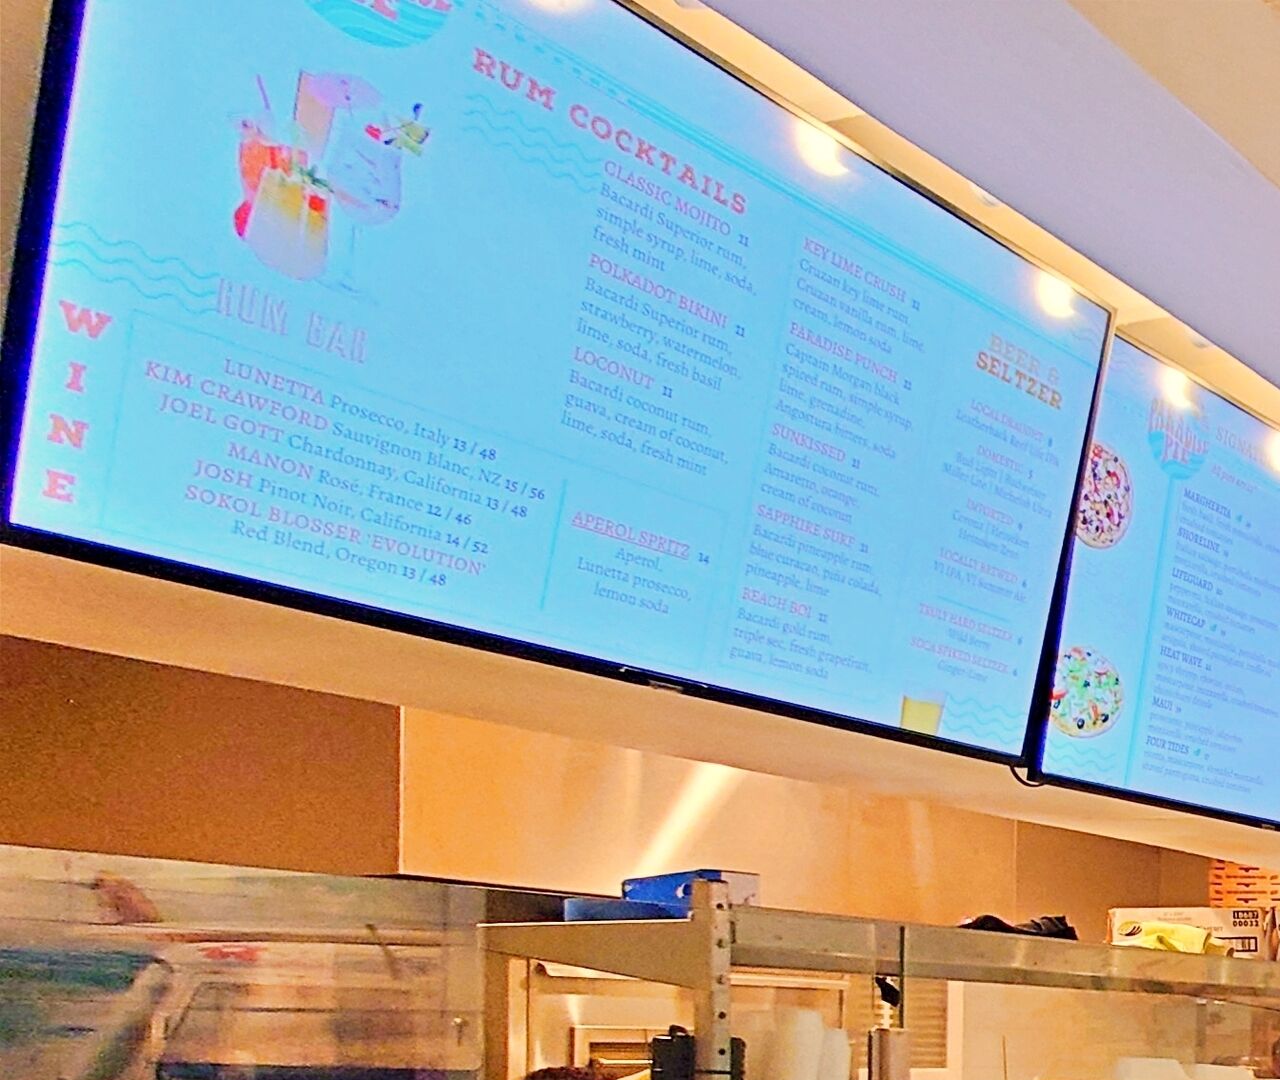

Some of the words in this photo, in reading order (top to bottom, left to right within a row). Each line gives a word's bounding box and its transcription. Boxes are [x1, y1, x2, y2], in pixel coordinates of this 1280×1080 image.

[472, 46, 556, 112] RUM
[568, 99, 747, 215] COCKTAILS
[600, 182, 653, 220] Bacardi
[656, 211, 714, 254] Superior
[715, 245, 747, 270] rum,
[603, 158, 672, 206] CLASSIC
[674, 196, 731, 238] MOJITO
[592, 223, 629, 254] fresh
[632, 243, 666, 272] mint
[595, 201, 644, 241] simple
[646, 230, 688, 263] syrup,
[690, 249, 723, 279] lime,
[724, 266, 758, 296] soda,
[803, 236, 829, 261] KEY
[830, 251, 863, 279] LIME
[863, 270, 906, 303] CRUSH
[214, 275, 292, 338] RUM
[304, 309, 370, 366] BAR
[584, 276, 638, 312] Bacardi
[640, 302, 699, 343] Superior
[701, 333, 733, 357] rum,
[589, 252, 676, 305] POLKADOT
[677, 294, 727, 329] BIKINI
[573, 345, 655, 391] LOCONUT
[576, 317, 614, 349] lime,
[615, 334, 654, 366] soda,
[655, 351, 690, 378] fresh
[691, 367, 722, 392] basil
[579, 297, 661, 347] strawberry,
[662, 334, 742, 381] watermelon,
[789, 321, 853, 363] PARADISE
[854, 353, 897, 384] PUNCH
[42, 300, 114, 504] WINE
[224, 358, 326, 405] LUNETTA
[329, 394, 408, 436] Prosecco,
[412, 422, 451, 451] Italy
[451, 439, 466, 456] 13
[478, 444, 497, 466] 48
[569, 368, 623, 402] Bacardi
[625, 391, 679, 424] coconut
[680, 417, 712, 439] rum,
[976, 350, 1062, 410] SELTZER
[144, 360, 192, 389] KIM
[199, 378, 328, 433] CRAWFORD
[331, 421, 422, 466] Sauvignon
[425, 452, 474, 482] Blanc,
[478, 469, 501, 488] NZ
[503, 481, 518, 497] 15
[528, 485, 545, 506] 56
[160, 393, 217, 425] JOEL
[222, 412, 284, 445] GOTT
[286, 432, 400, 484] Chardonnay,
[403, 469, 482, 506] California
[484, 498, 499, 515] 13
[510, 502, 528, 523] 48
[560, 410, 598, 439] lime,
[599, 425, 638, 453] soda,
[639, 440, 674, 464] fresh
[676, 453, 707, 476] mint
[564, 393, 611, 423] guava,
[614, 412, 656, 436] cream
[658, 425, 676, 444] of
[674, 431, 729, 466] coconut,
[772, 422, 846, 464] SUNKISSED
[185, 483, 262, 518] SOKOL
[268, 506, 361, 544] BLOSSER
[193, 459, 253, 490] JOSH
[258, 477, 307, 505] Pinot
[312, 493, 357, 521] Noir,
[359, 506, 442, 542] California
[445, 535, 460, 551] 14
[471, 542, 489, 559] 52
[227, 441, 312, 481] MANON
[317, 468, 364, 499] Rosé,
[367, 483, 423, 513] France
[426, 505, 442, 519] 12
[454, 509, 472, 531] 46
[231, 519, 269, 542] Red
[272, 530, 331, 560] Blend,
[334, 546, 398, 578] Oregon
[401, 567, 416, 583] 13
[428, 571, 447, 591] 48
[571, 510, 637, 542] APEROL
[637, 531, 690, 558] SPRITZ
[577, 556, 630, 582] Lunetta
[632, 575, 692, 603] prosecco,
[593, 581, 637, 605] lemon
[638, 594, 670, 614] soda
[1171, 567, 1213, 592] LIFEGUARD
